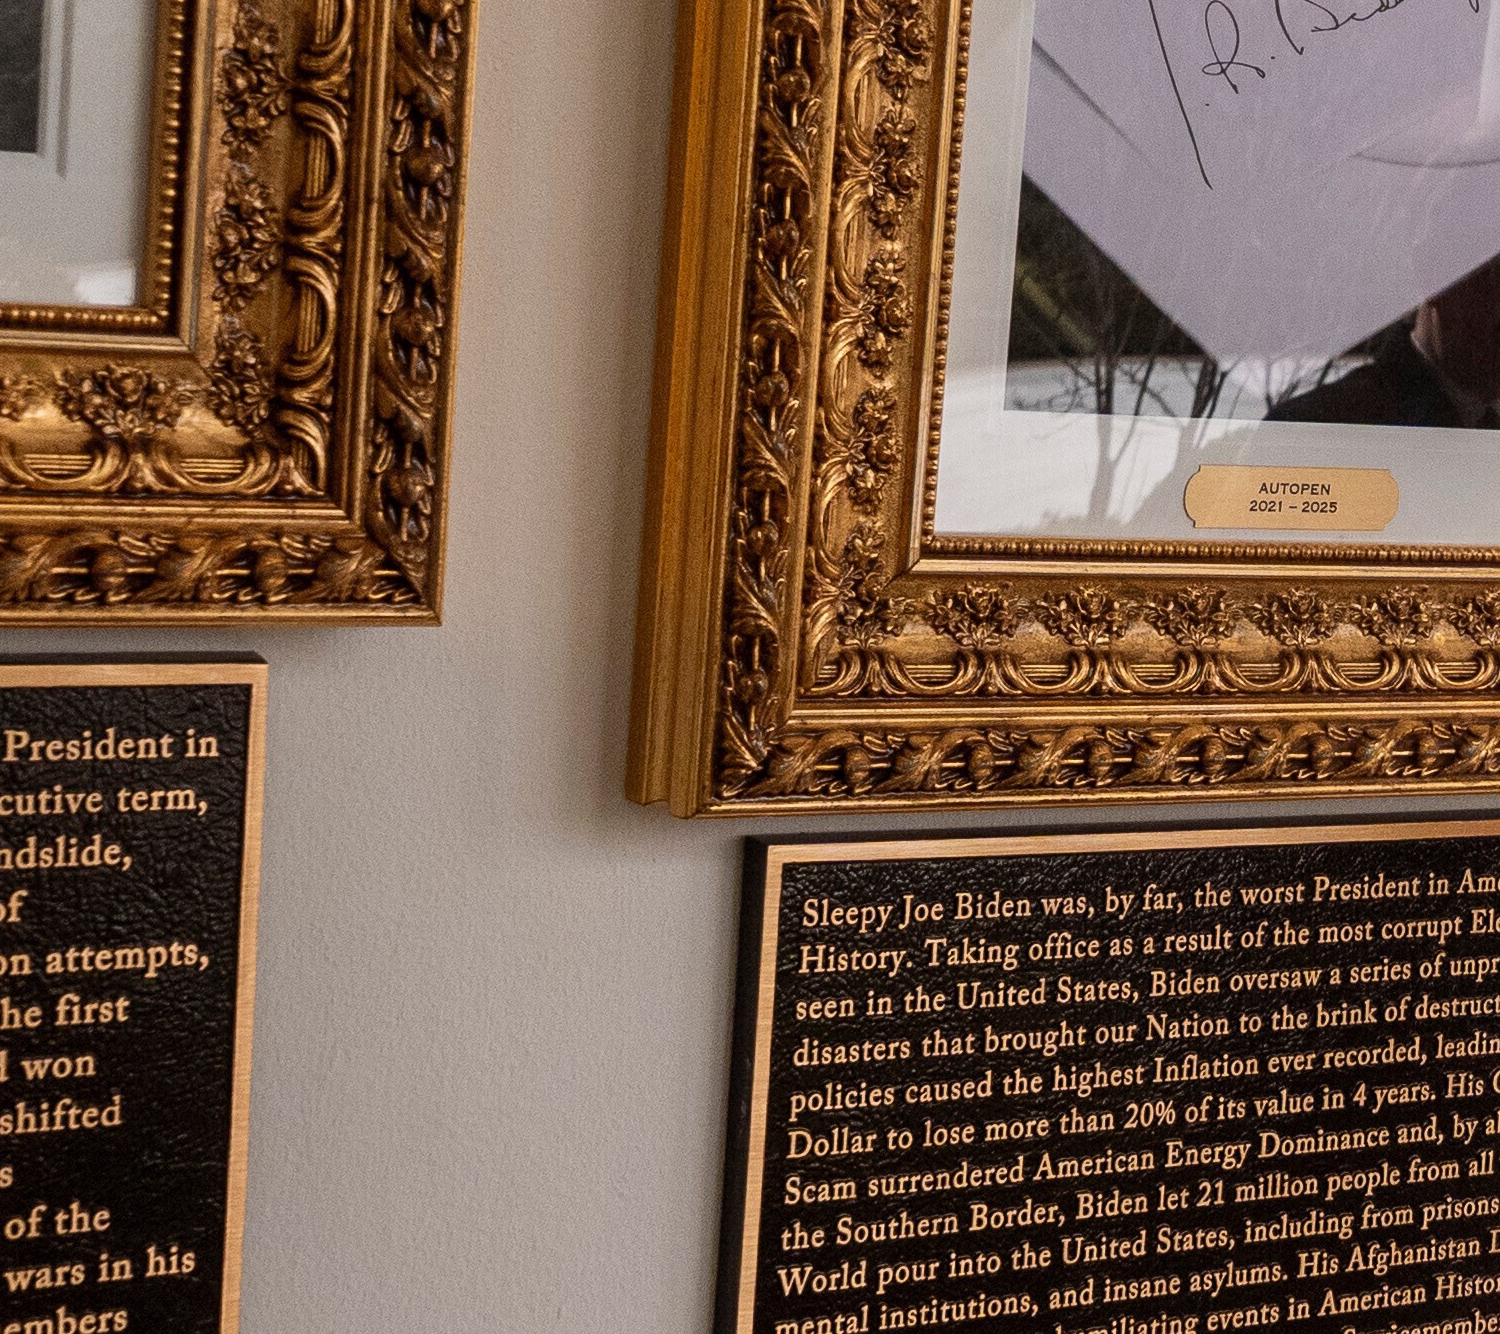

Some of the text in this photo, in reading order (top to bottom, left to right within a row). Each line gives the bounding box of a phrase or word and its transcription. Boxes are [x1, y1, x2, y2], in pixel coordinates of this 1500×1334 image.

[1259, 482, 1330, 496] AUTOPEN
[1249, 500, 1282, 512] 2021
[1302, 502, 1337, 513] 2025
[2, 727, 175, 763] President
[184, 727, 220, 758] in
[803, 898, 894, 936] Sleepy
[898, 894, 944, 930] Joe
[954, 890, 1031, 920] Biden
[1041, 896, 1095, 919] was,
[1105, 886, 1135, 920] by
[1142, 883, 1183, 914] far,
[1194, 881, 1232, 908] the
[1240, 883, 1305, 905] worst
[1313, 872, 1421, 902] President
[1427, 872, 1449, 896] in
